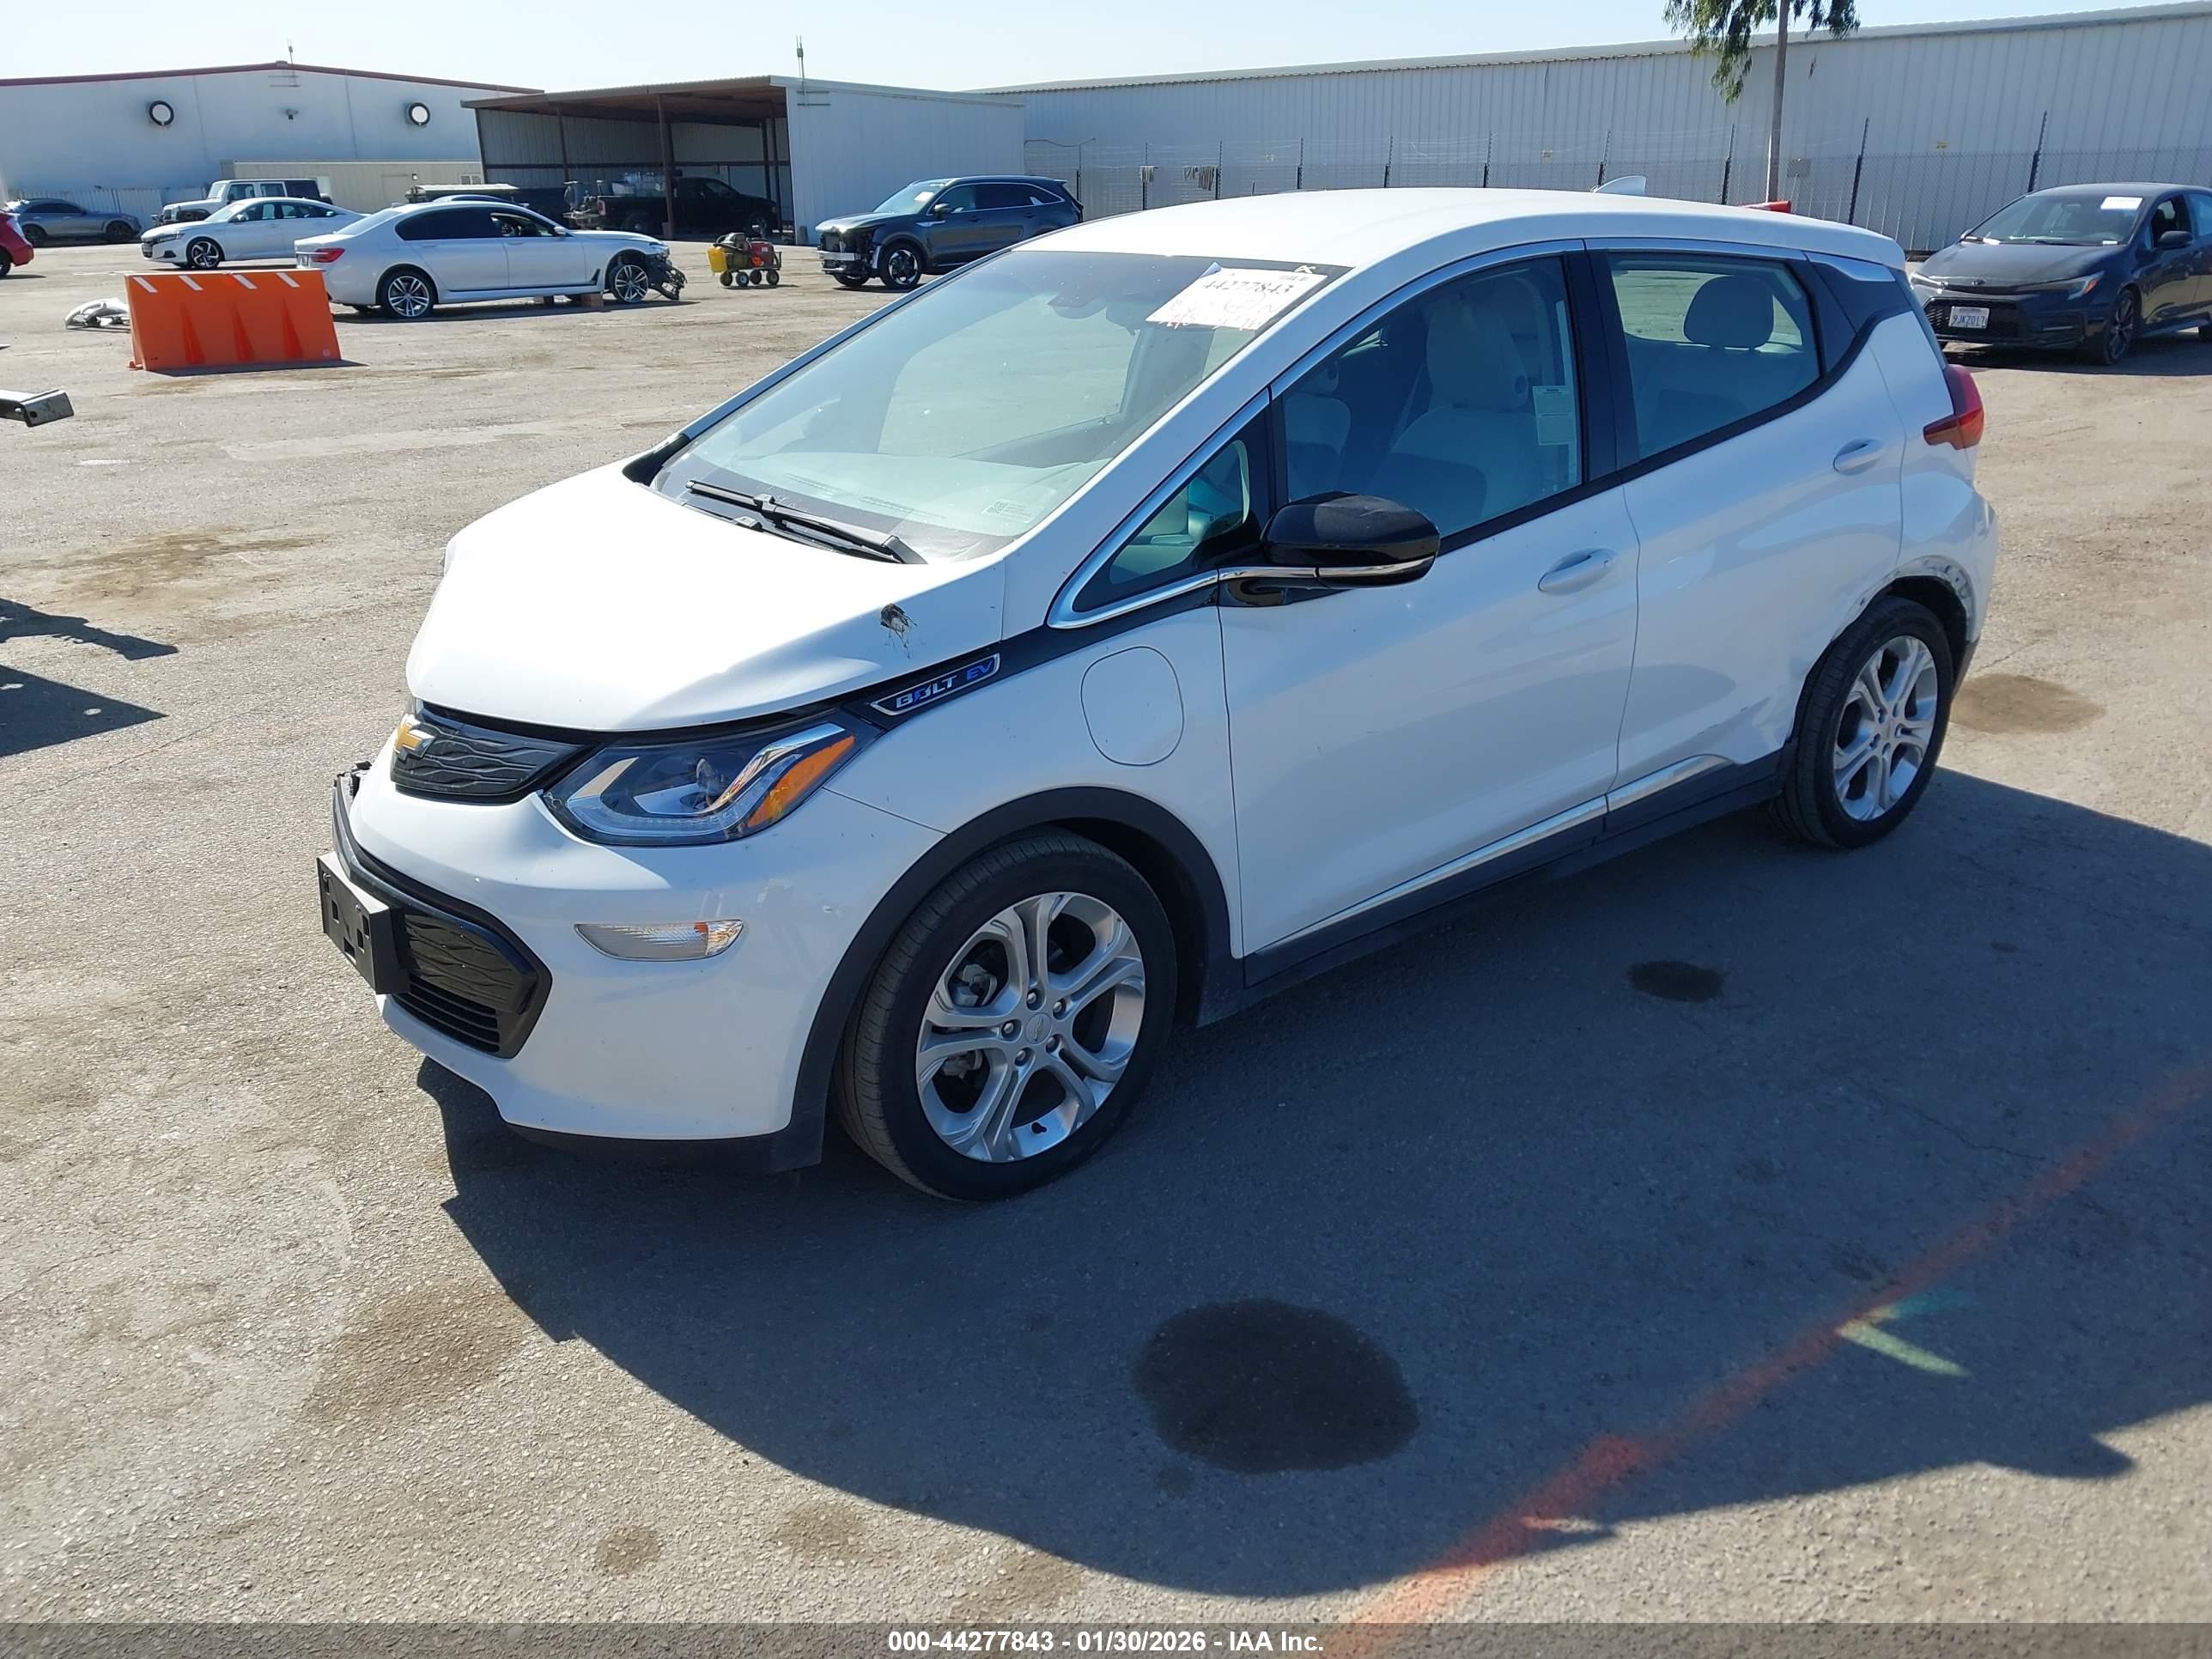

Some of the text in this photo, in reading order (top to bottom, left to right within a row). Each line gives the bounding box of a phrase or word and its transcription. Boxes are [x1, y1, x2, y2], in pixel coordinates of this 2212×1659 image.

[1204, 281, 1294, 295] 44277843
[896, 660, 994, 708] BOLT EV
